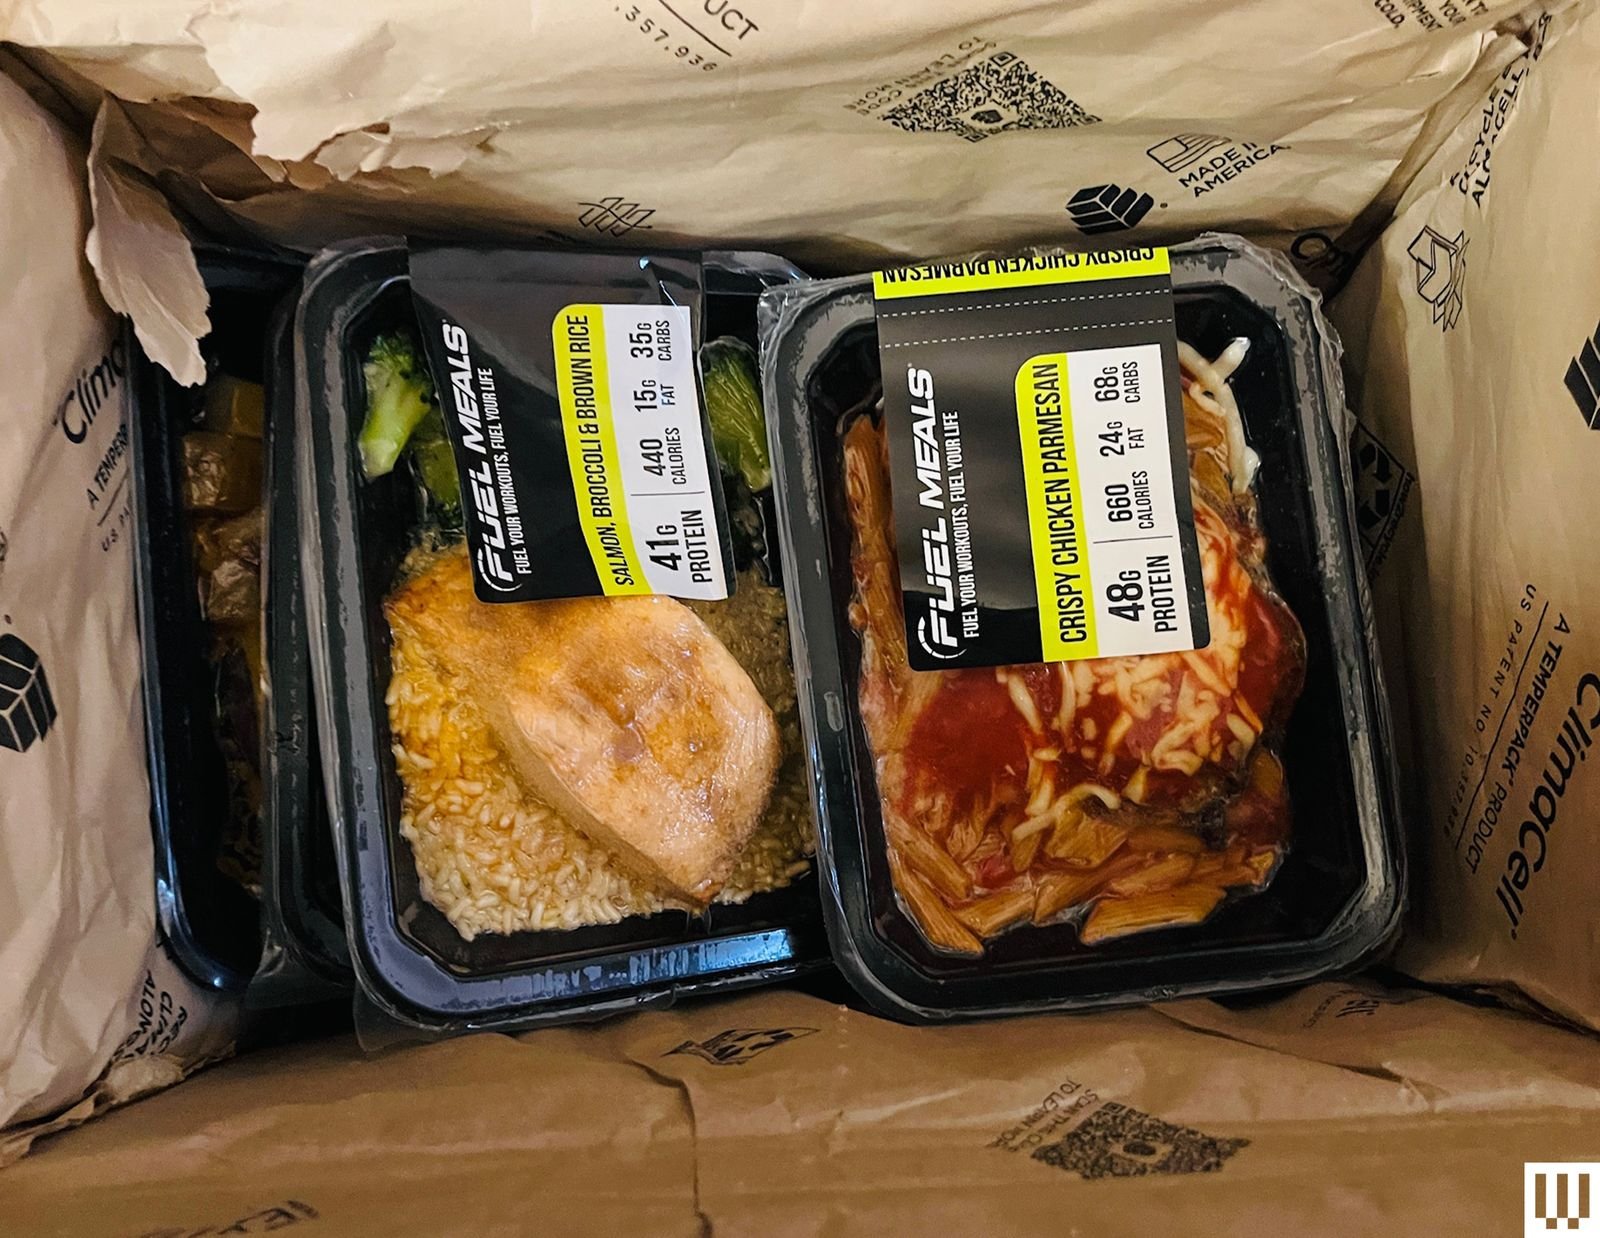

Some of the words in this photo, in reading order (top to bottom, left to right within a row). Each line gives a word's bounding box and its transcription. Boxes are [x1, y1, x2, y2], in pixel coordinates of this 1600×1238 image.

[1178, 147, 1242, 188] MADE
[1194, 143, 1286, 198] AMERICA
[566, 315, 591, 353] RICE
[629, 322, 654, 359] 35G
[655, 320, 672, 361] CARBS
[442, 323, 487, 455] MEALS
[477, 367, 496, 391] LIFE
[570, 358, 597, 419] BROWN
[633, 379, 658, 413] 15G
[660, 383, 676, 406] FAT
[1093, 366, 1120, 402] 68G
[1122, 361, 1141, 403] CARBS
[481, 392, 501, 421] YOUR
[942, 411, 960, 437] LIFE
[1032, 363, 1069, 474] PARMESAN
[487, 422, 507, 450] FUEL
[578, 423, 599, 434] &
[907, 367, 945, 510] MEALS
[1098, 421, 1125, 457] 24G
[1127, 427, 1145, 450] FAT
[639, 438, 667, 476] 440
[665, 427, 687, 485] CALORIES
[945, 438, 963, 472] YOUR
[86, 488, 100, 510] A
[493, 451, 519, 515] WORKOUTS,
[580, 439, 613, 518] BROCCOLI
[948, 472, 966, 502] FUEL
[1104, 484, 1133, 522] 660
[1132, 470, 1155, 530] CALORIES
[468, 460, 514, 583] FUEL
[505, 516, 526, 547] YOUR
[951, 503, 974, 573] WORKOUTS,
[1043, 478, 1079, 566] CHICKEN
[513, 547, 532, 575] FUEL
[596, 522, 634, 586] SALMON,
[646, 524, 682, 571] 41G
[681, 509, 713, 583] PROTEIN
[921, 517, 958, 648] FUEL
[958, 574, 977, 607] YOUR
[1106, 570, 1145, 622] 48G
[1146, 555, 1178, 633] PROTEIN
[1519, 583, 1537, 612] US
[962, 608, 980, 638] FUEL
[1054, 571, 1087, 643] CRISPY
[1554, 613, 1571, 634] A
[1489, 619, 1523, 699] PATENT
[1501, 640, 1563, 777] TEMPERPACK
[1465, 780, 1508, 875] PRODUCT
